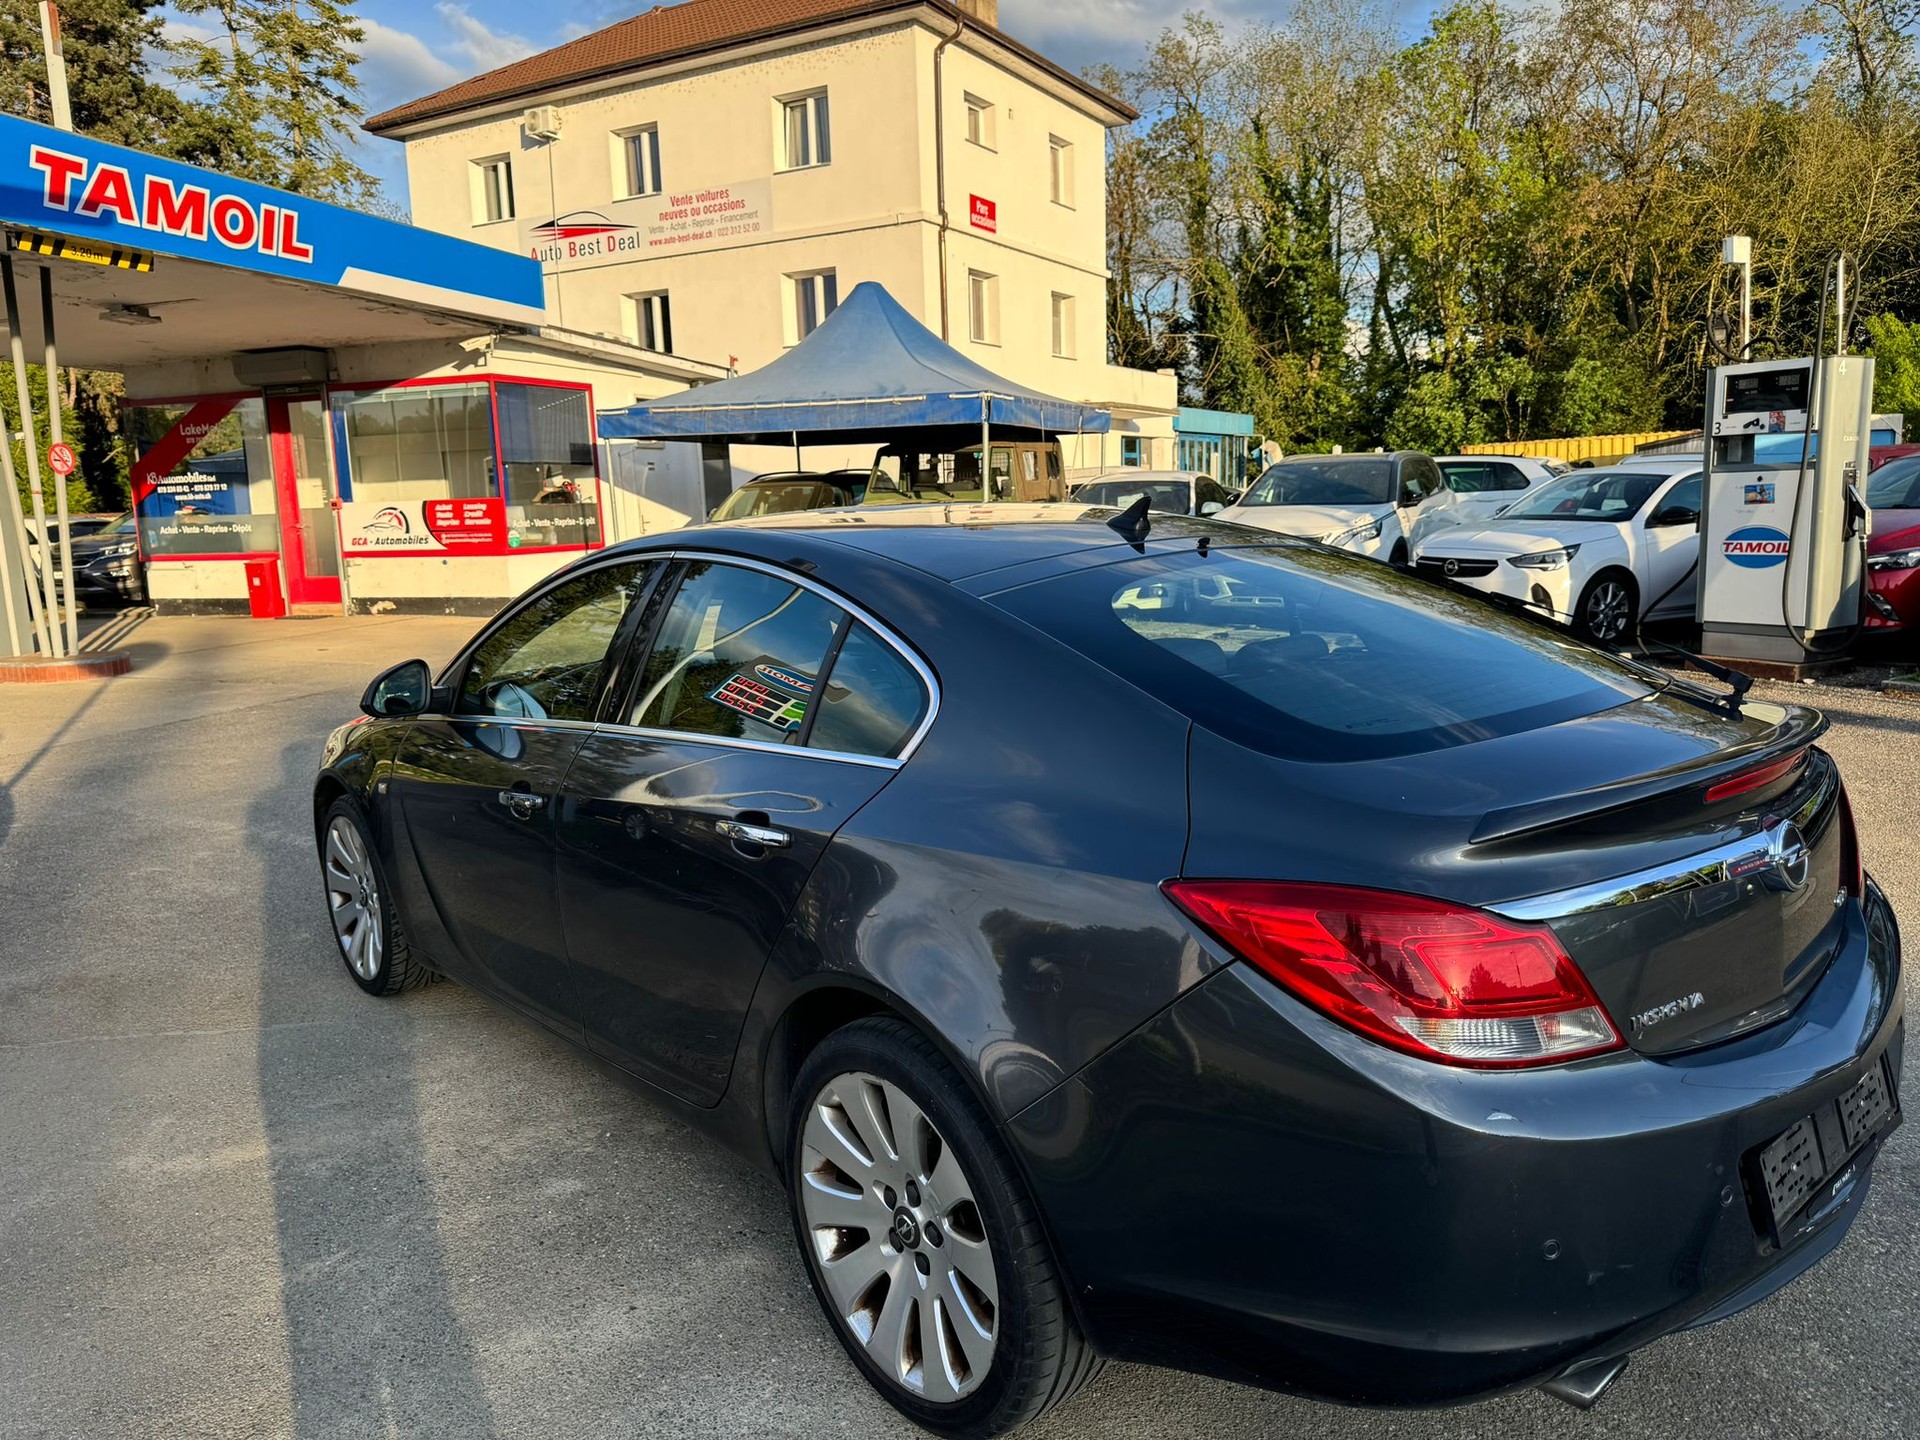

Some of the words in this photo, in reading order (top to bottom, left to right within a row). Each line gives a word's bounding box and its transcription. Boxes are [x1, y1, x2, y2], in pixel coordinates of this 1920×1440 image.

[30, 145, 313, 263] TAMOIL
[670, 195, 693, 208] Vente
[695, 189, 730, 203] voitures
[659, 209, 688, 222] neuves
[690, 207, 701, 217] ou
[703, 199, 746, 215] occasions
[648, 226, 665, 235] Vente
[670, 222, 687, 232] Achat
[720, 210, 759, 223] Financement
[649, 231, 713, 246] www.auto-best-deal.ch
[717, 226, 729, 237] 022
[730, 225, 742, 235] 312
[743, 223, 751, 233] 52
[752, 222, 761, 232] 00
[70, 245, 92, 258] 3.20
[531, 245, 562, 262] Auto
[568, 238, 602, 258] Best
[607, 231, 640, 253] Deal
[1838, 359, 1848, 376] 4
[1714, 422, 1722, 435] 3
[158, 472, 208, 484] Automobiles
[160, 526, 179, 535] Achat
[181, 525, 200, 534] Vente
[204, 524, 228, 535] Reprise
[232, 523, 252, 534] Dépôt
[352, 537, 368, 546] GCA
[374, 535, 429, 546] Automobiles
[1723, 542, 1790, 553] TAMOIL
